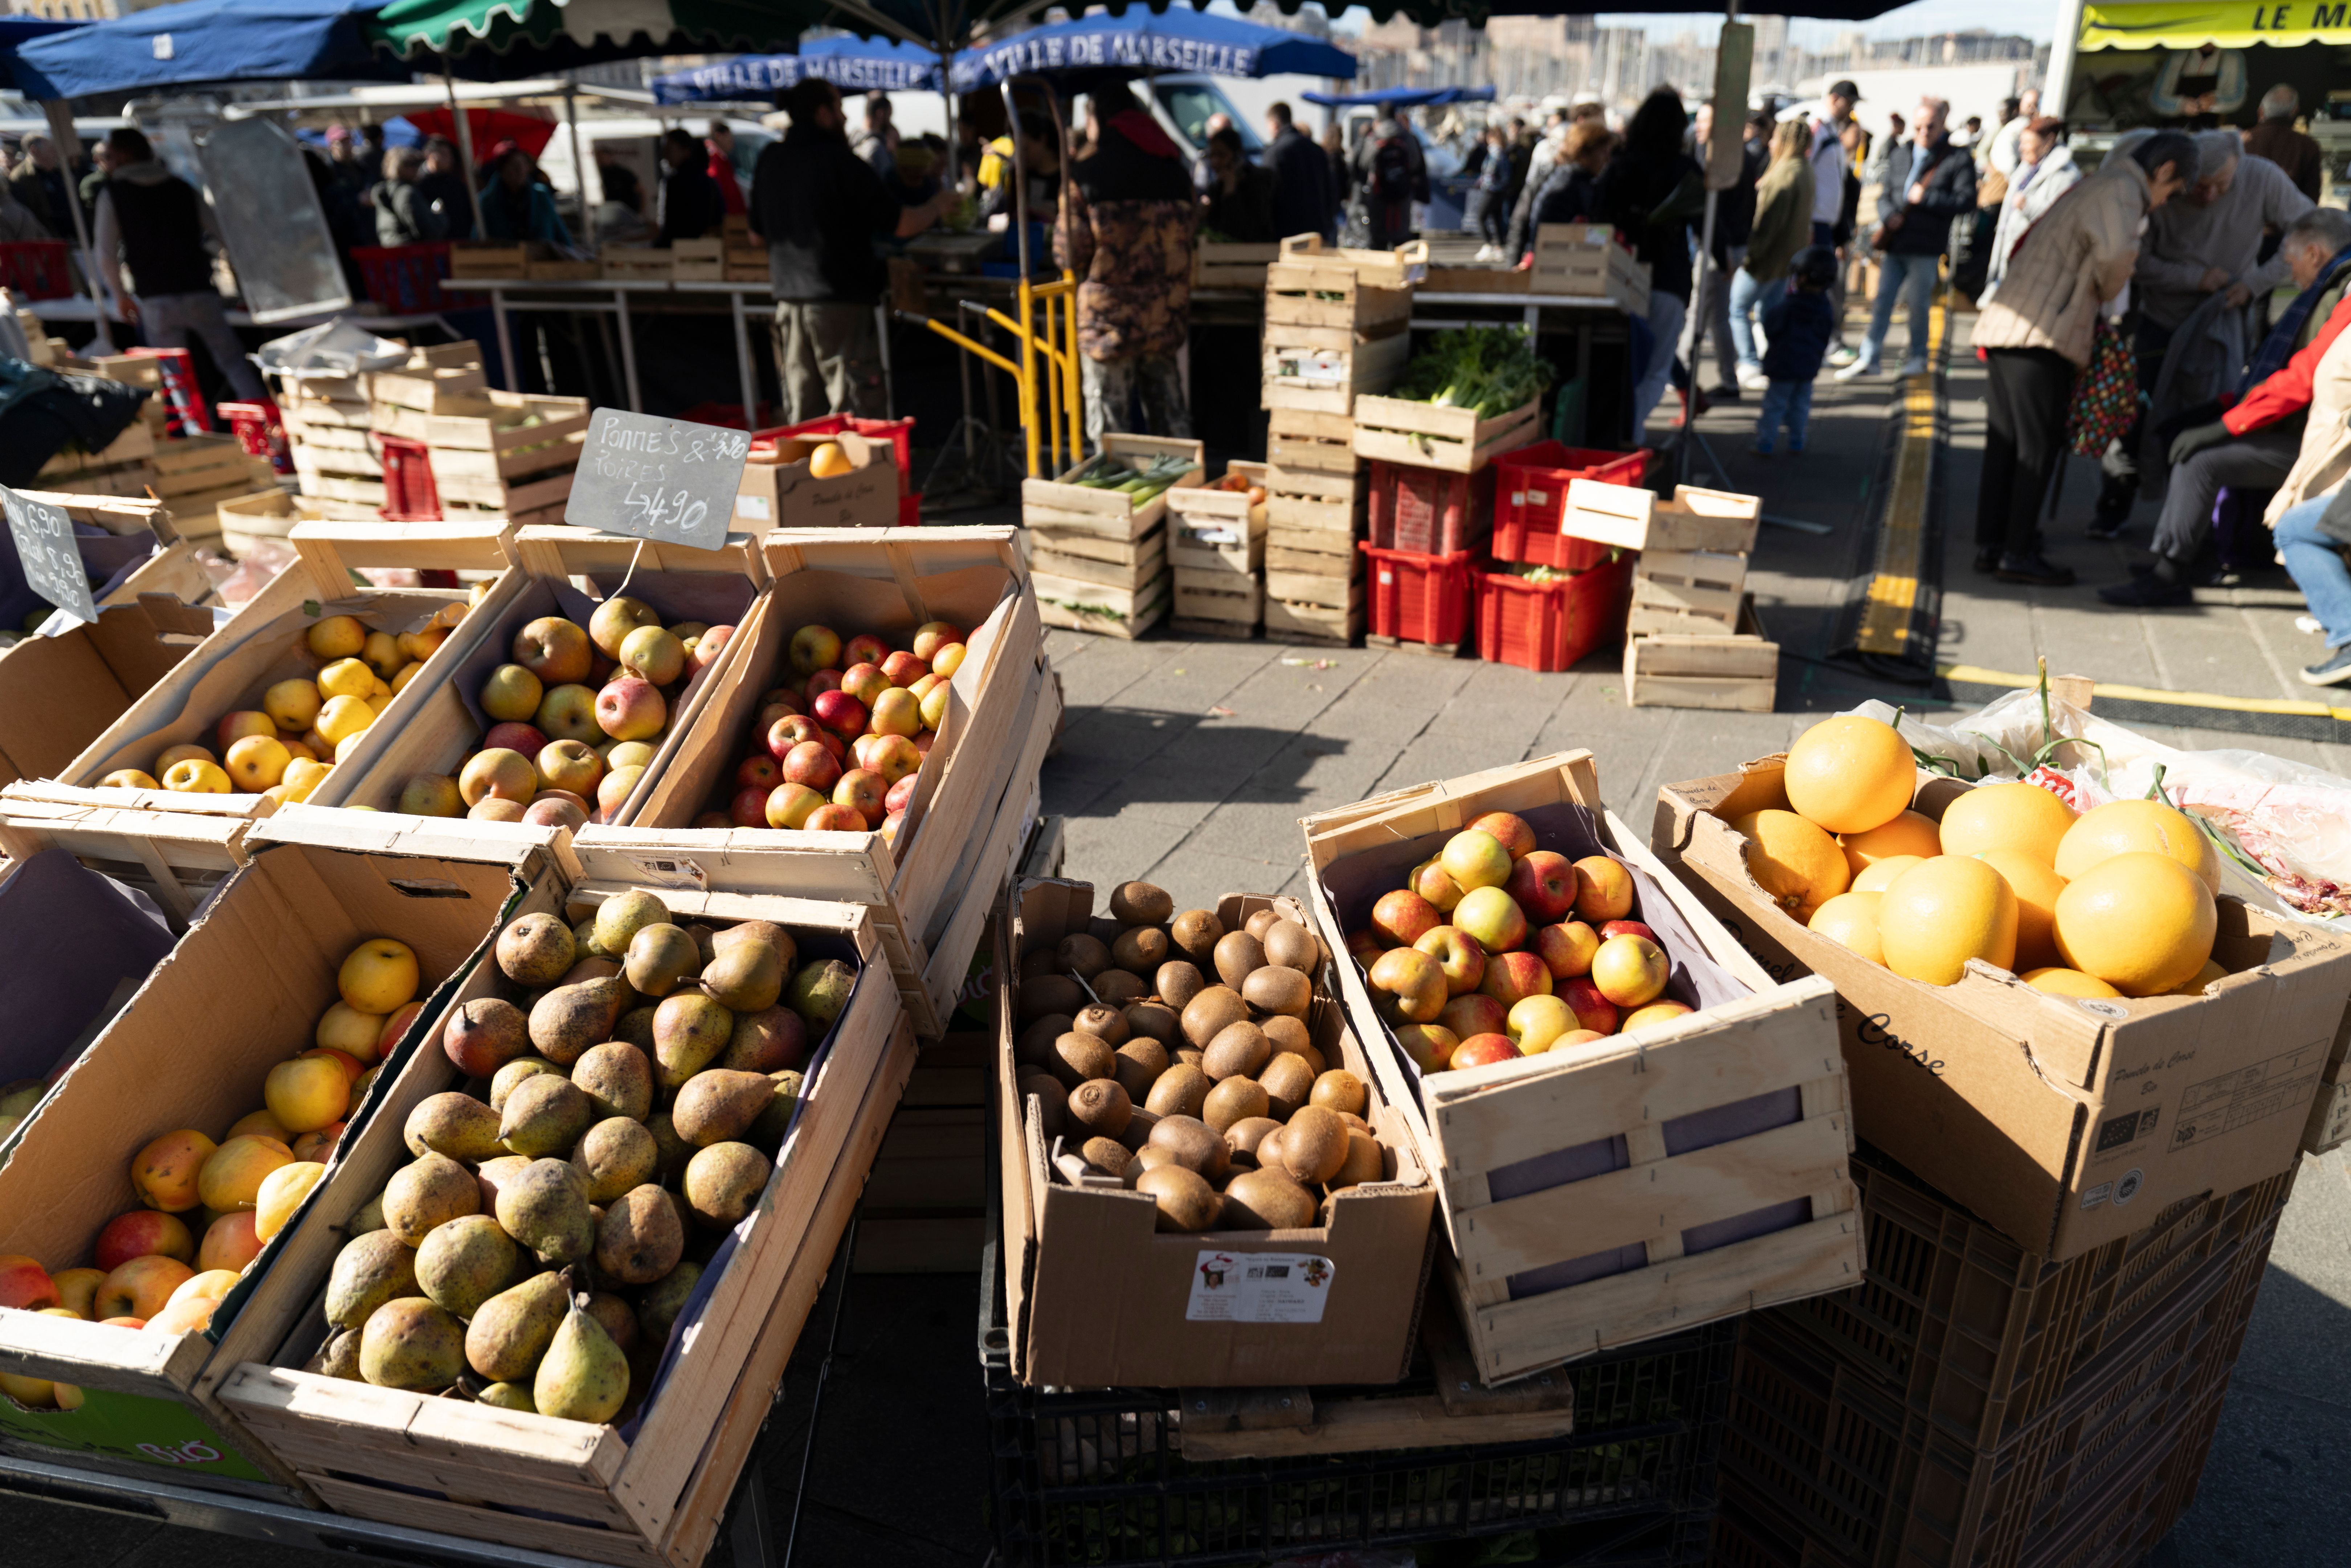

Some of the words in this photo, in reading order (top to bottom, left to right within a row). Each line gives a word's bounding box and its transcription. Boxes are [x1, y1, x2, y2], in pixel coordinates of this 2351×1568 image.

[2252, 3, 2290, 30] LE
[984, 37, 1064, 78] VILLE
[1071, 34, 1105, 65] DE
[1113, 34, 1251, 77] MARSEILLE
[693, 61, 761, 94] VILLE
[767, 58, 798, 87] DE
[804, 57, 925, 89] MARSEILLE
[27, 503, 61, 538] 6,90
[1857, 1013, 1945, 1077] Corse
